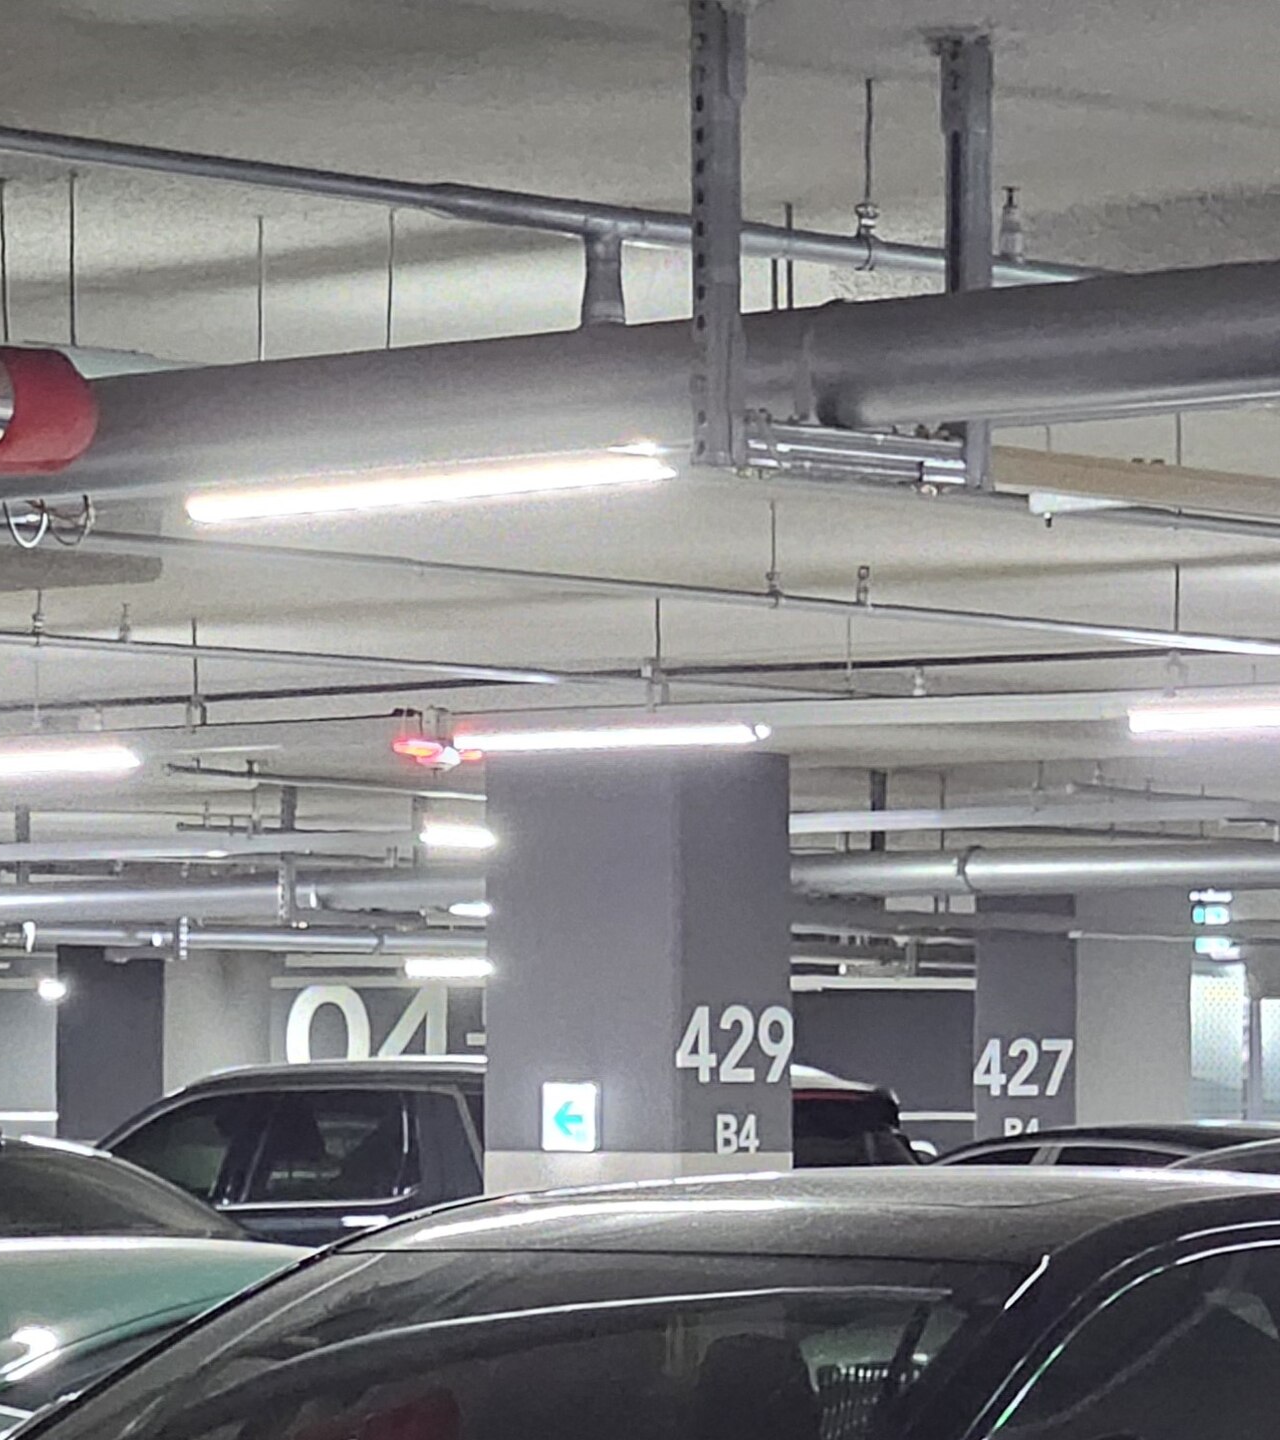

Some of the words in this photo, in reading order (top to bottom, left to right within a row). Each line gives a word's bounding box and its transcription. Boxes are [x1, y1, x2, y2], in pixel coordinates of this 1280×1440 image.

[286, 984, 487, 1064] 04
[675, 1005, 794, 1083] 429
[973, 1038, 1074, 1096] 427
[716, 1114, 760, 1155] B4
